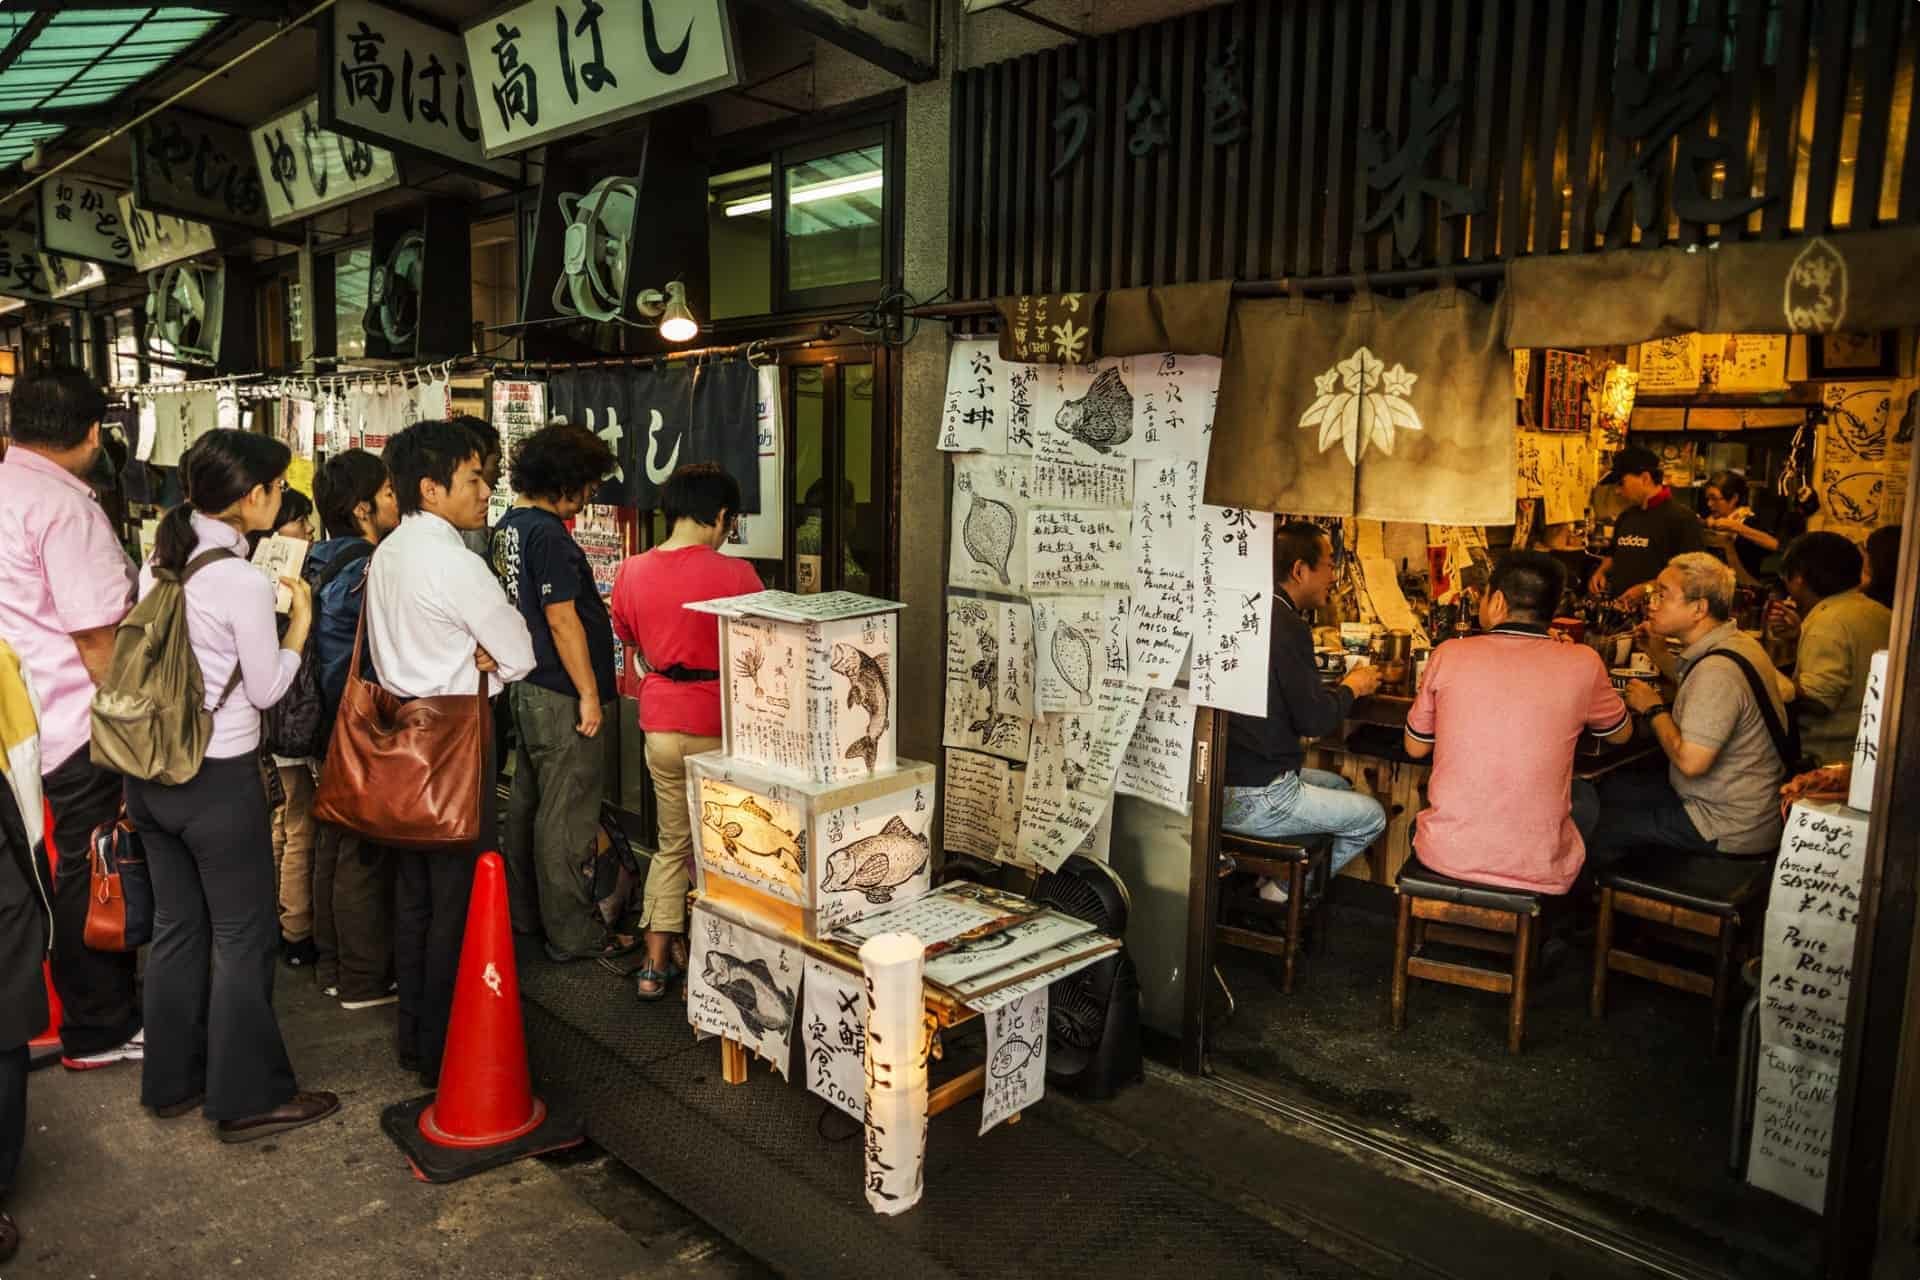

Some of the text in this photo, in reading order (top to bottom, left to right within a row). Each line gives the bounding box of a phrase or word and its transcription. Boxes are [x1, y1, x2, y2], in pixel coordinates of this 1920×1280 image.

[341, 21, 480, 142] 高はし
[490, 0, 694, 132] 高はし
[1221, 507, 1257, 557] 味噌
